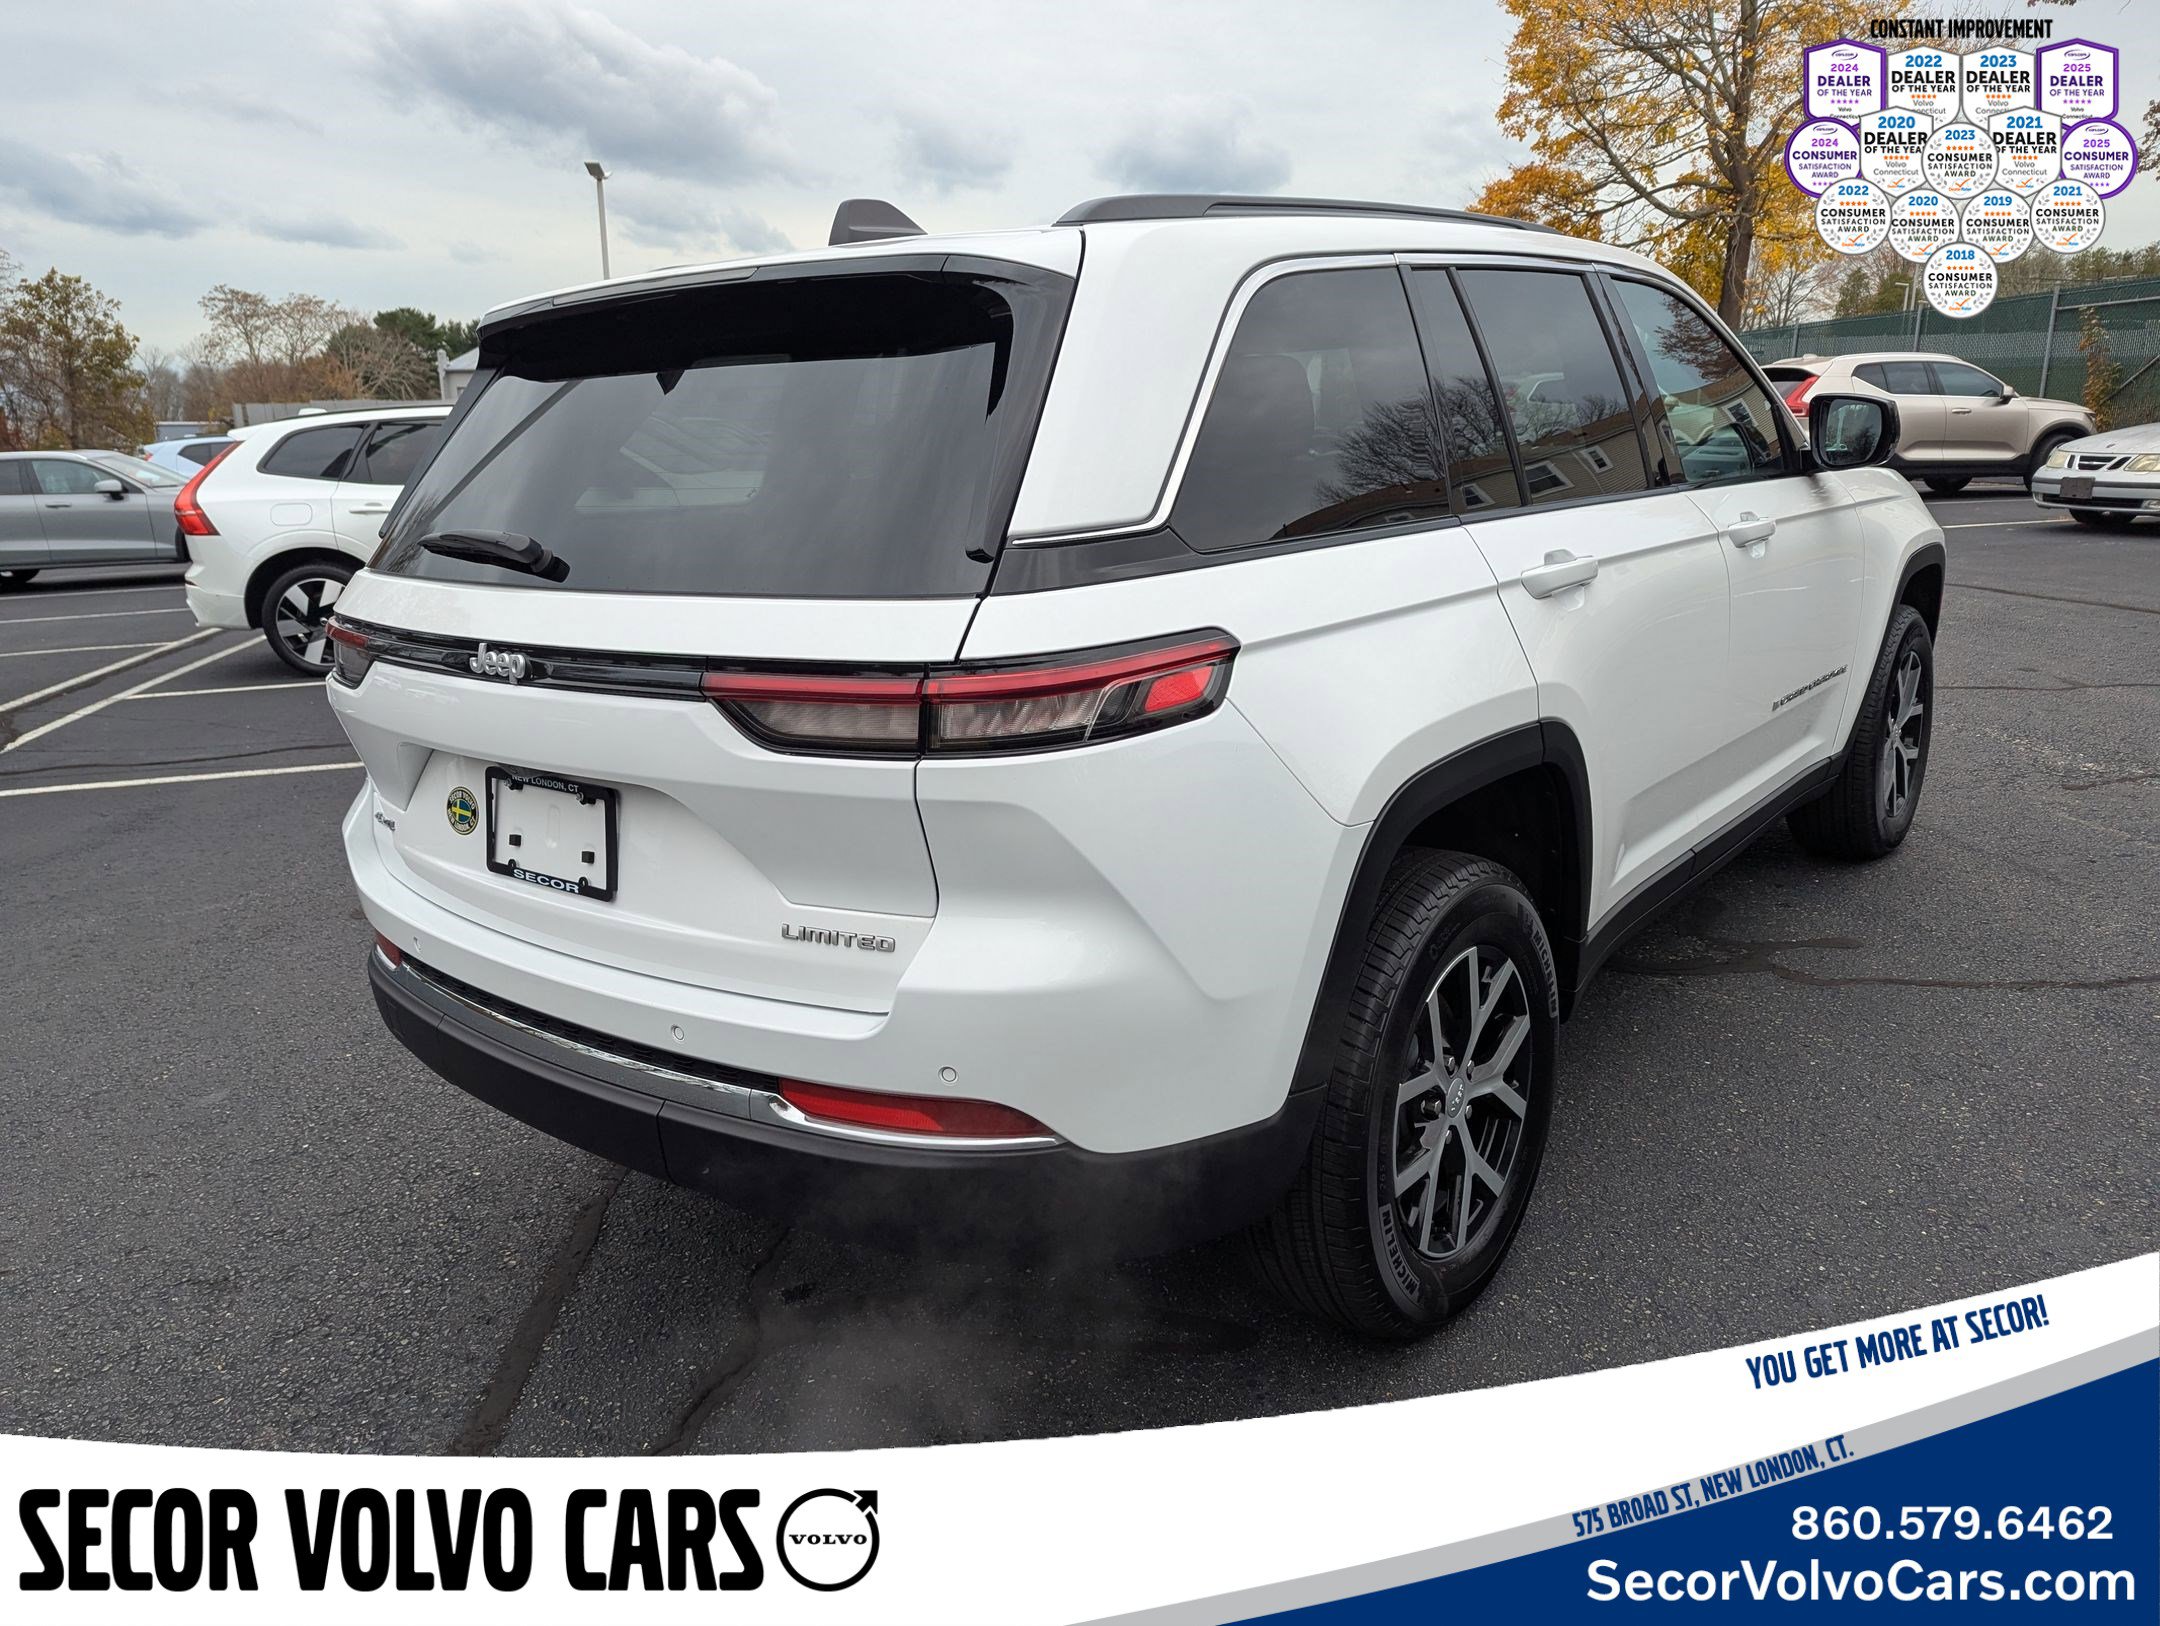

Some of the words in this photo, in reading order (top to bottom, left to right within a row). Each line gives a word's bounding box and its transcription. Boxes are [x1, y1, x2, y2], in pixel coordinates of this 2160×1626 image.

[470, 643, 526, 684] Jeep
[568, 784, 579, 792] CT
[513, 868, 580, 893] SECOR
[782, 923, 895, 952] LIMITED
[1382, 1209, 1418, 1296] MICHELIN
